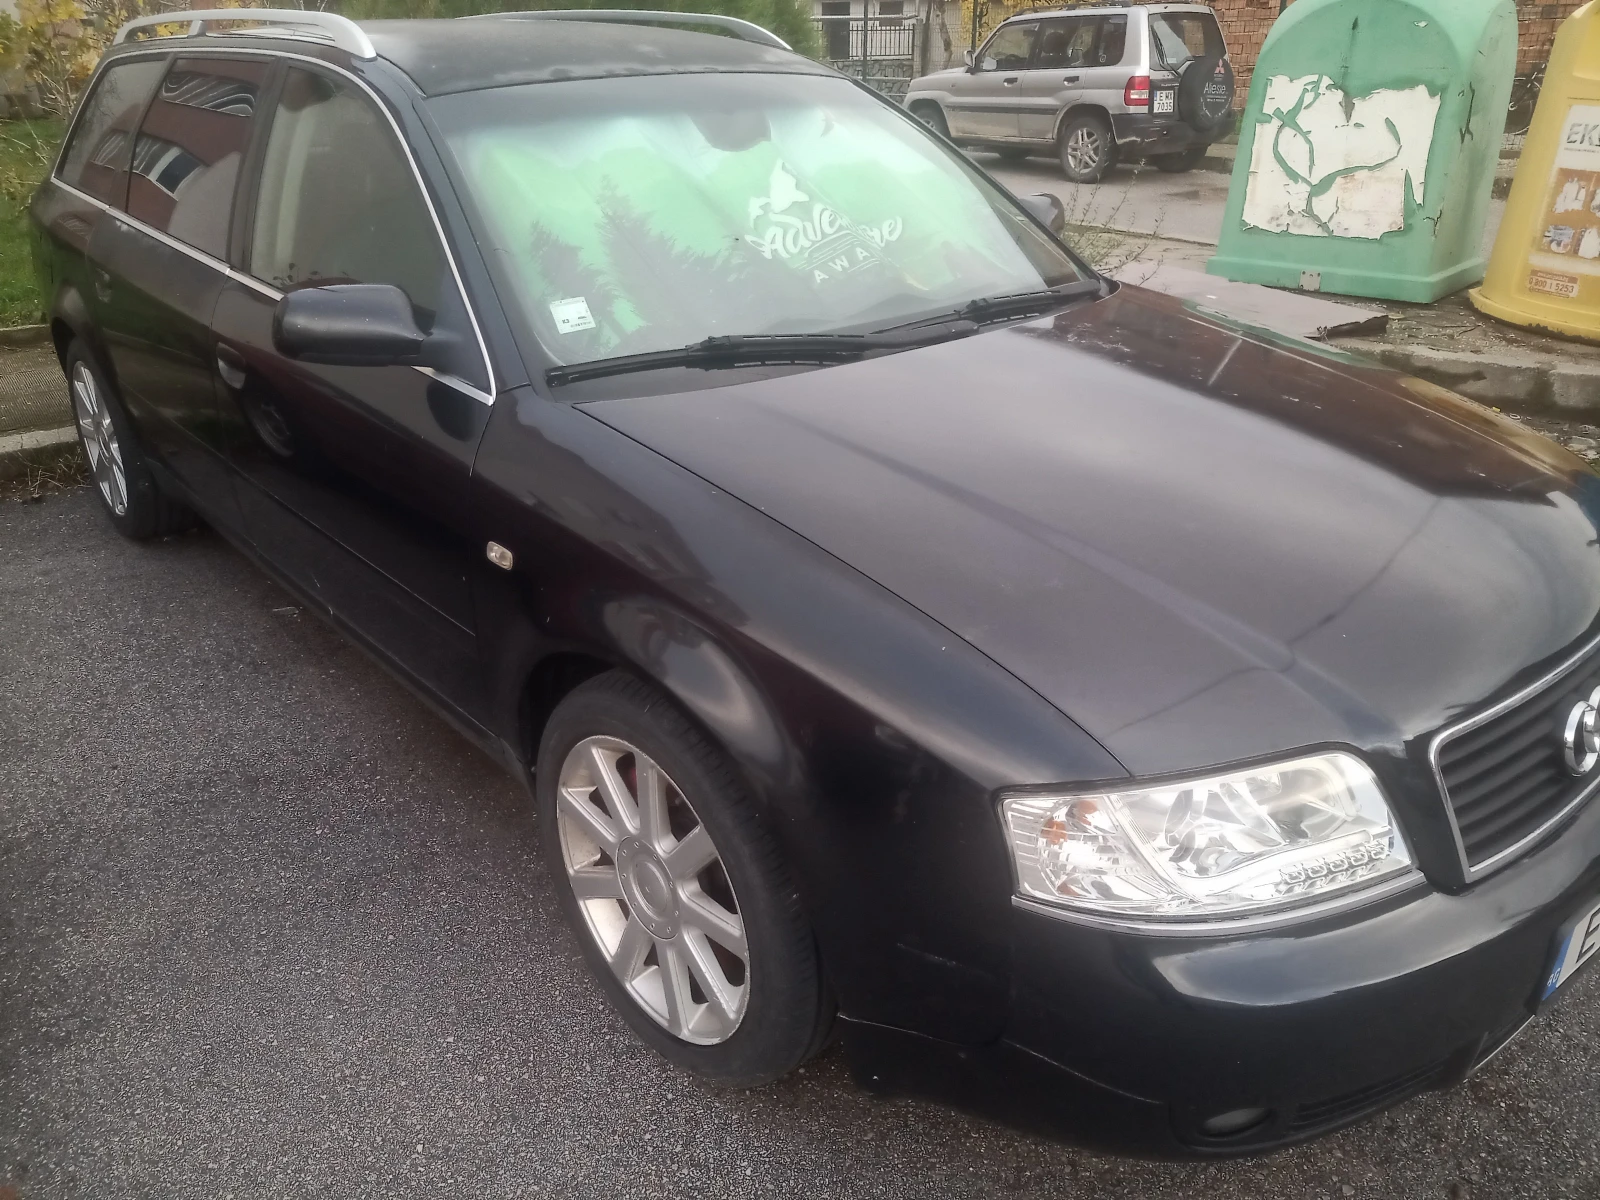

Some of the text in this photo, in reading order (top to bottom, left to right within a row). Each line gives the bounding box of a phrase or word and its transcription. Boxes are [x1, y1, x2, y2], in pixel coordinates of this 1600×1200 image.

[1159, 92, 1164, 101] E
[1156, 102, 1173, 112] 7035
[813, 247, 870, 283] AWA
[1555, 283, 1574, 293] 5253
